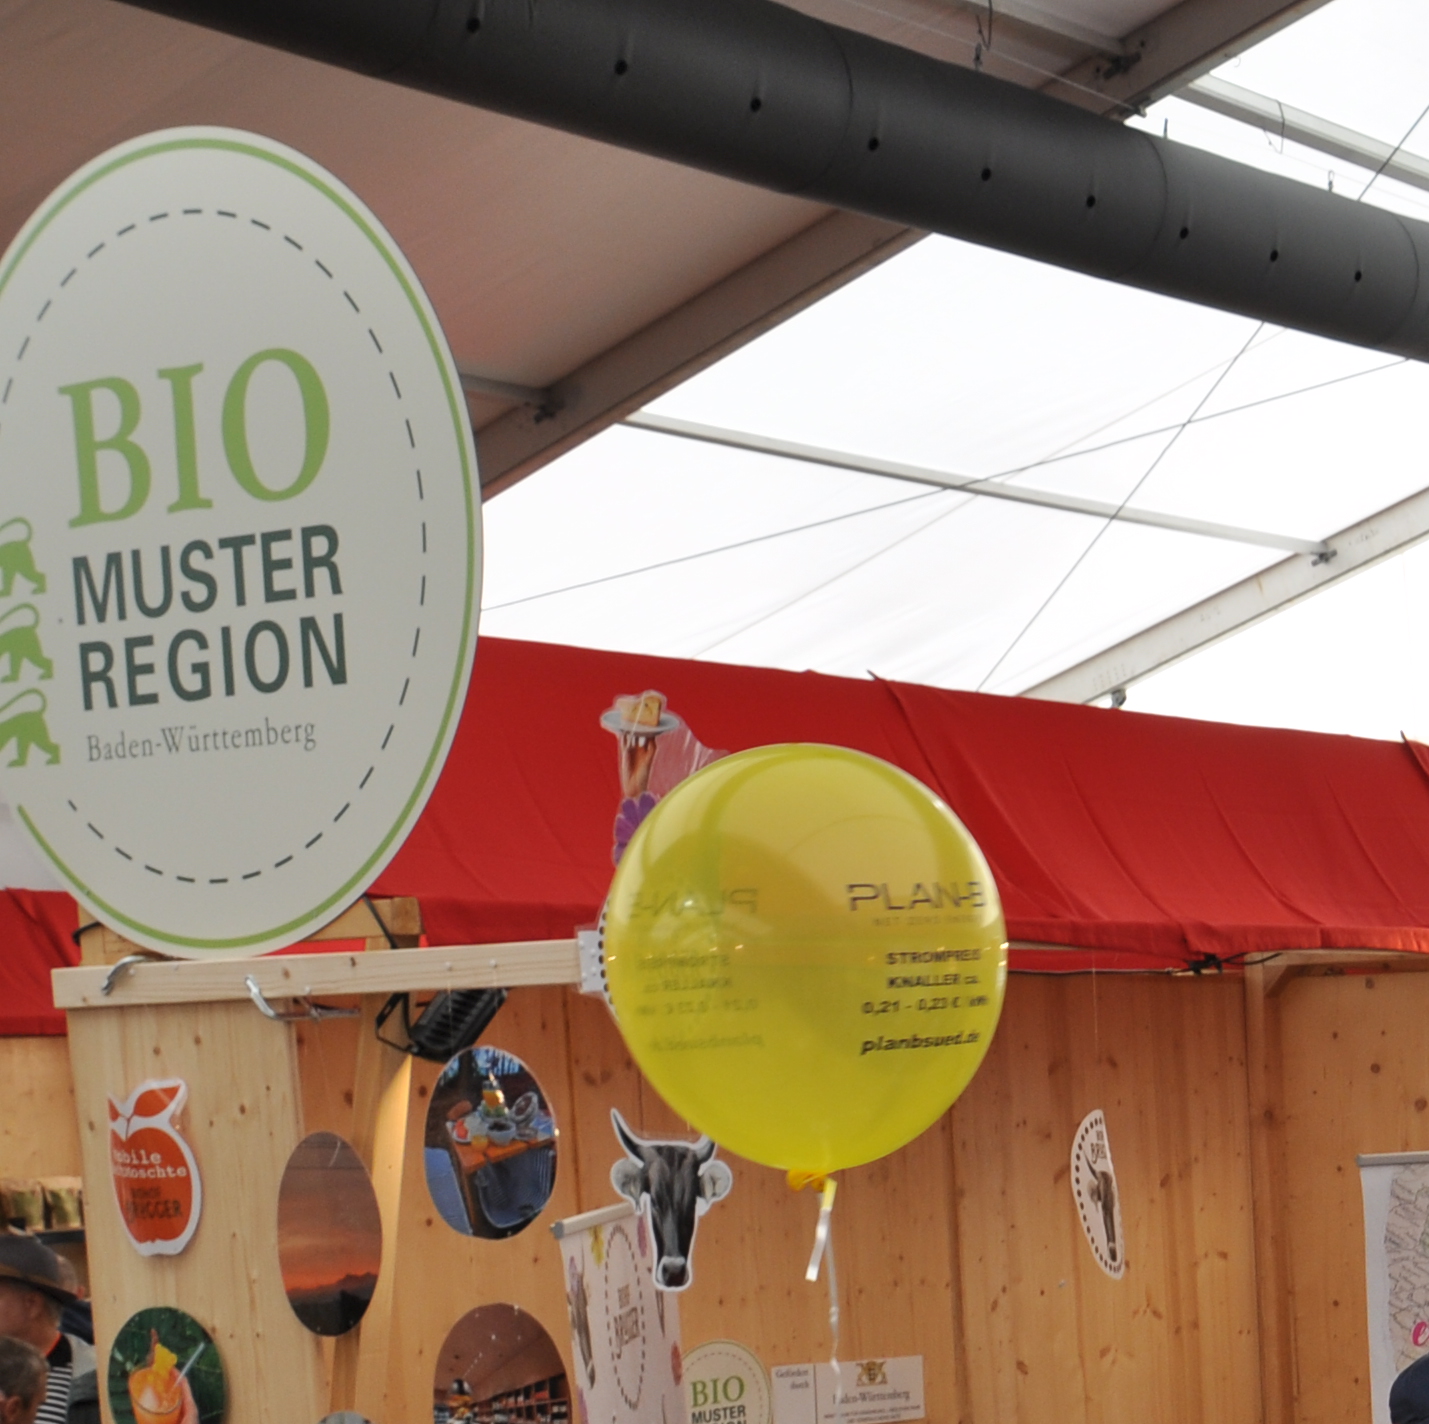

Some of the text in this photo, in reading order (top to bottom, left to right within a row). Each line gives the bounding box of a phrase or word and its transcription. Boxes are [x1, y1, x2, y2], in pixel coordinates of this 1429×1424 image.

[57, 347, 331, 529] BIO
[72, 524, 344, 625] MUSTER
[78, 612, 348, 711] REGION
[86, 719, 317, 762] Baden-Württemberg
[691, 1375, 745, 1408] BIO
[691, 1405, 746, 1424] MUSTER
